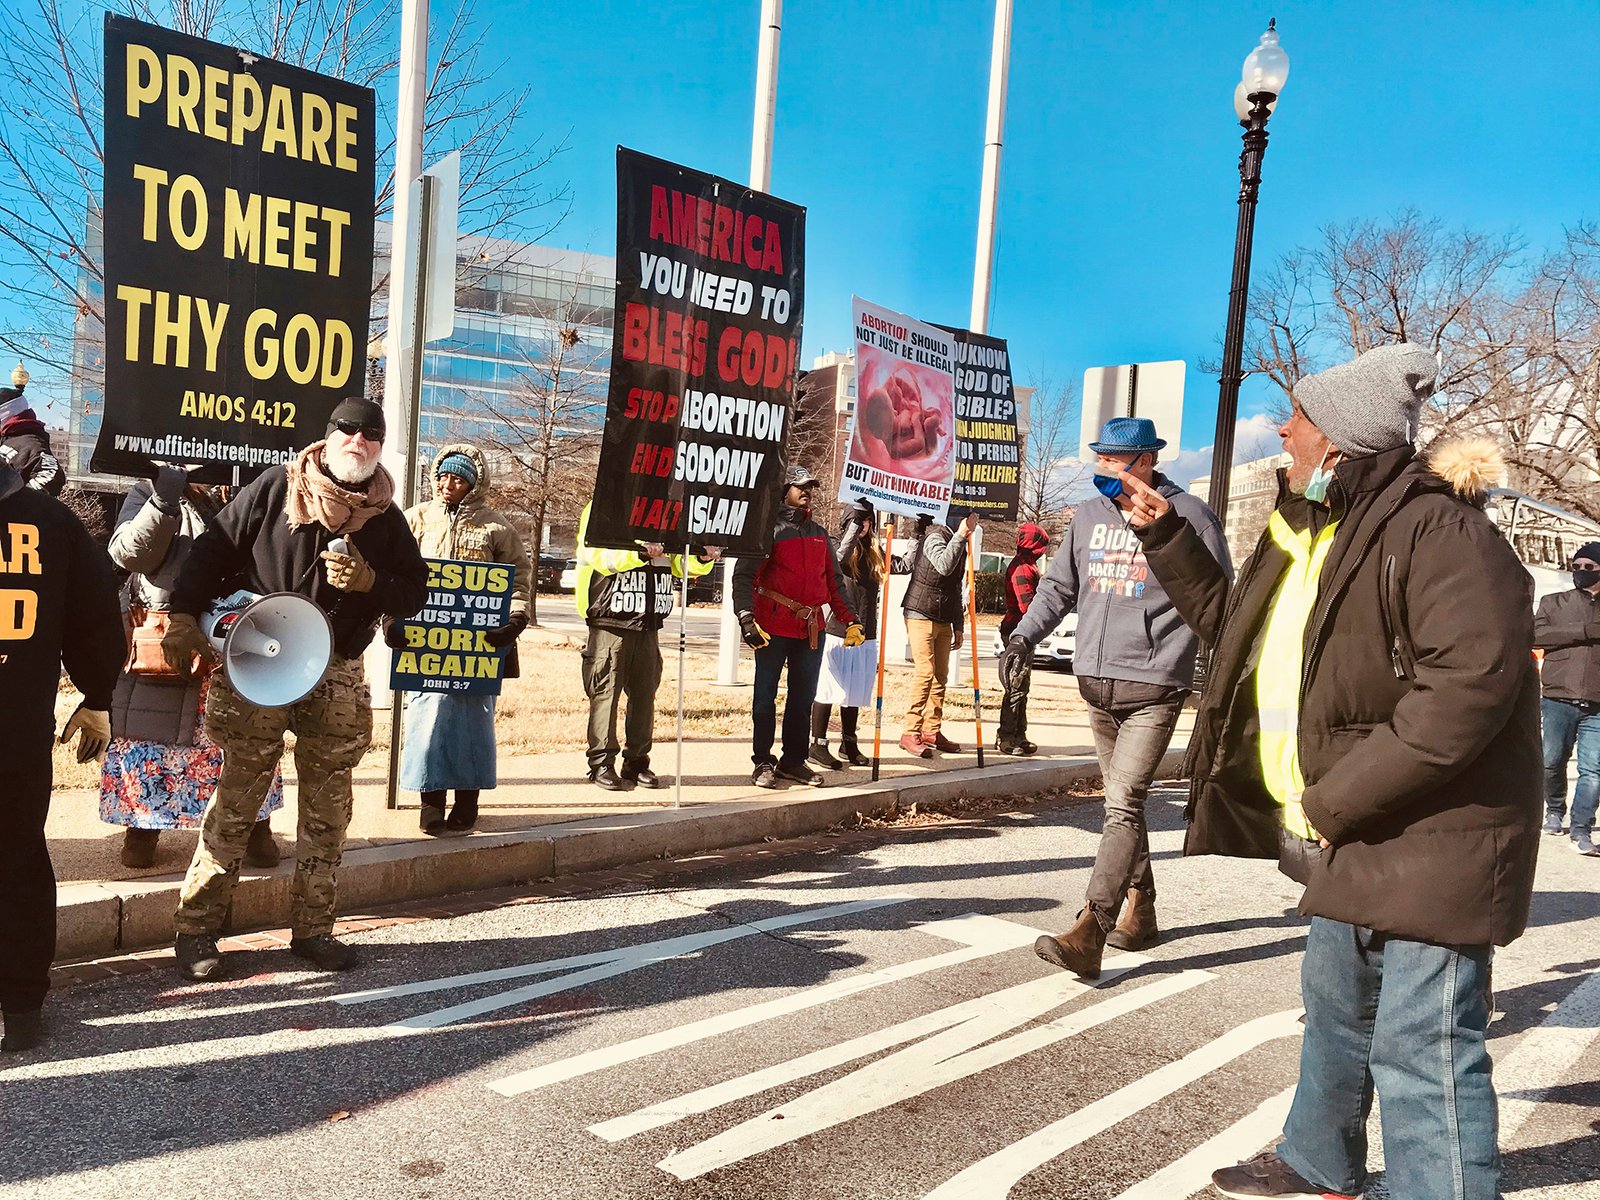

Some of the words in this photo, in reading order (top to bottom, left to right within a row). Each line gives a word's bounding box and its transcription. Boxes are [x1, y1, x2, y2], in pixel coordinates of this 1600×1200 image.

[126, 43, 358, 172] PREPARE
[133, 164, 208, 250] TO
[224, 187, 351, 277] MEET
[650, 184, 783, 275] AMERICA
[640, 252, 687, 299] YOU
[690, 268, 753, 315] NEED
[761, 285, 791, 325] TO
[117, 284, 230, 372] THY
[244, 308, 354, 389] GOD
[623, 302, 709, 377] BLESS
[717, 326, 796, 393] GOD!
[856, 326, 876, 344] NOT
[879, 335, 899, 354] JUST
[902, 344, 913, 360] BE
[916, 349, 953, 374] ILLEGAL
[911, 332, 948, 356] SHOULD
[956, 367, 988, 391] GOD
[991, 373, 1010, 395] OF
[180, 390, 246, 423] AMOS
[251, 399, 296, 428] 4:12
[624, 387, 679, 423] STOP
[680, 389, 785, 442] ABORTION
[957, 394, 1014, 420] BIBLE?
[969, 421, 1016, 442] JUDGMENT
[114, 434, 299, 468] www.officialstreetpreach
[630, 443, 675, 478] END
[674, 440, 765, 489] SODOMY
[978, 443, 1018, 463] PERISH
[845, 463, 870, 483] BUT
[871, 470, 950, 501] UNTHINKABLE
[972, 464, 1018, 484] HELLFIRE
[629, 496, 683, 531] HALT
[688, 495, 749, 536] ISLAM
[426, 562, 509, 593] ESUS
[461, 594, 503, 610] YOU
[611, 592, 646, 613] GOD
[472, 612, 501, 627] BE
[404, 625, 496, 653] BORN
[395, 651, 500, 679] AGAIN
[422, 679, 450, 689] JOHN
[452, 681, 471, 690] 3:7
